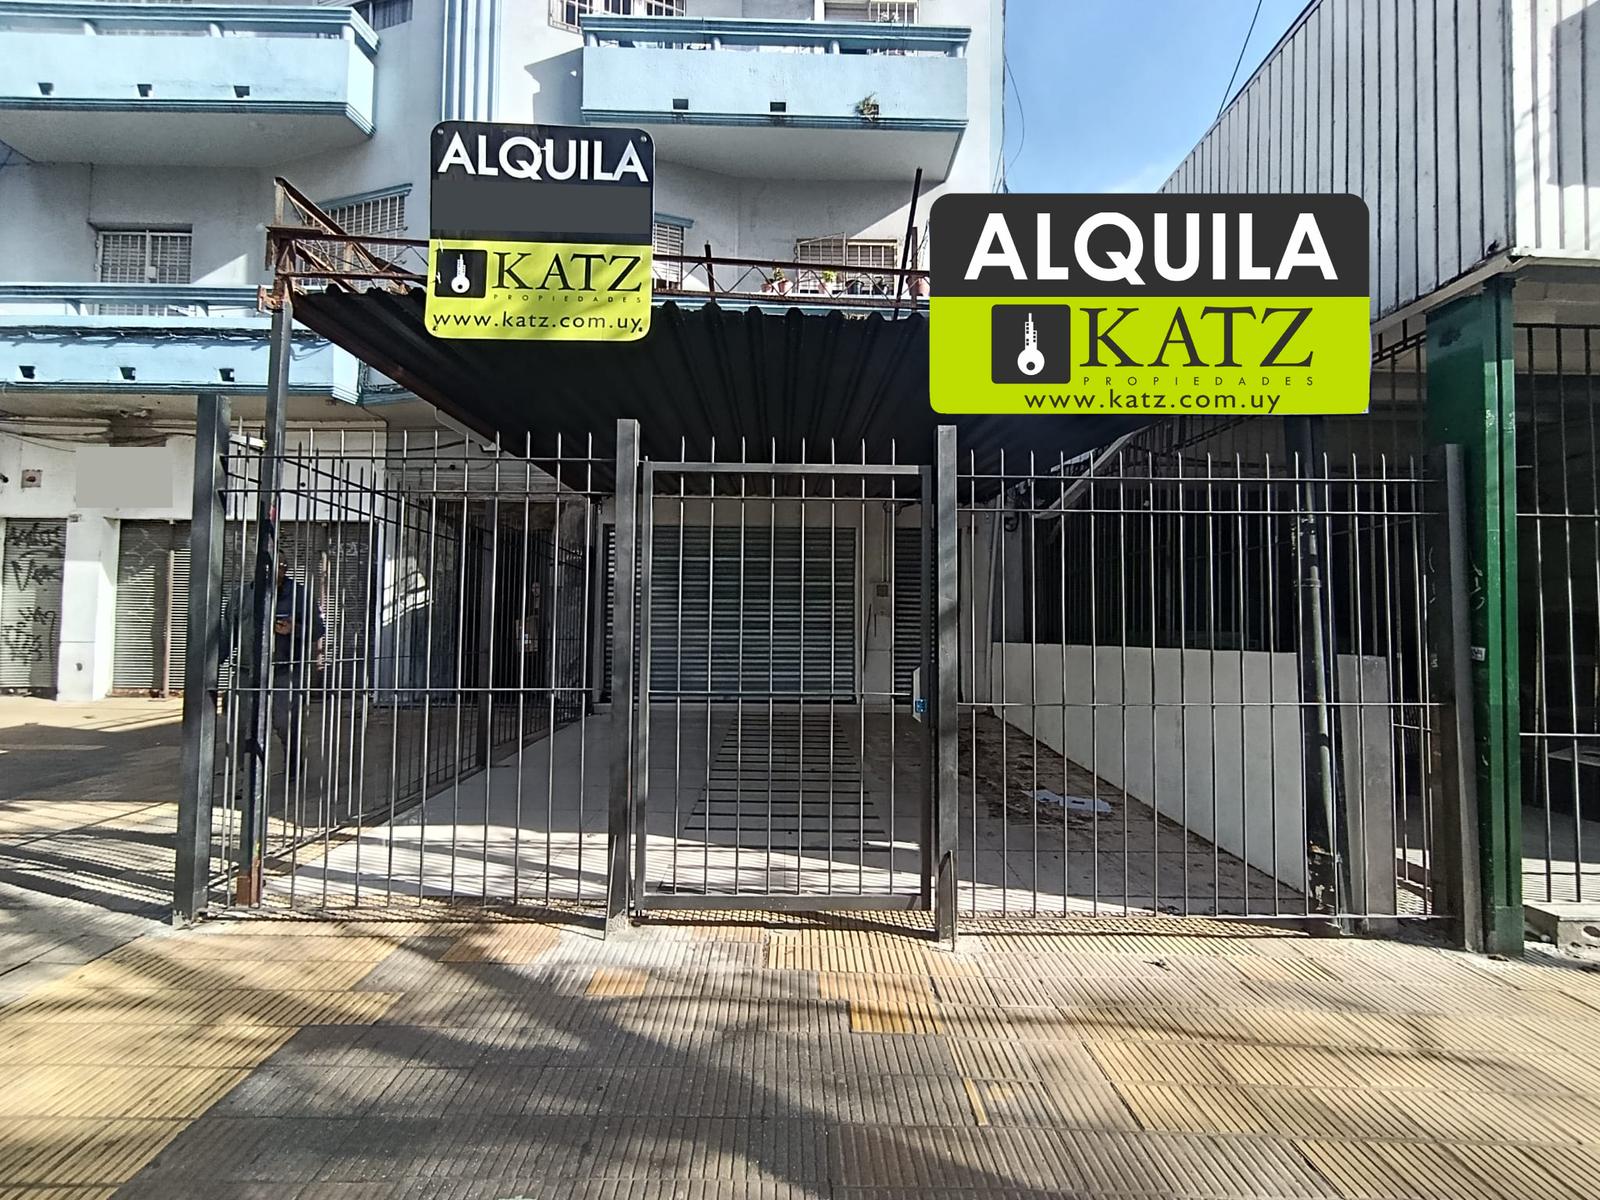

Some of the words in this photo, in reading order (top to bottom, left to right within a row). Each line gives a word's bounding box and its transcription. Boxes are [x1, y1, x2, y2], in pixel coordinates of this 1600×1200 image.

[437, 131, 649, 182] ALQUILA
[964, 211, 1338, 285] ALQUILA
[491, 251, 642, 293] KATZ
[493, 293, 641, 303] PROPIEDADES
[432, 311, 643, 334] www.katz.com.uy
[1079, 306, 1314, 369] KATZ
[1083, 376, 1314, 387] PROPIEDADES
[1024, 389, 1281, 414] www.katz.com.uy
